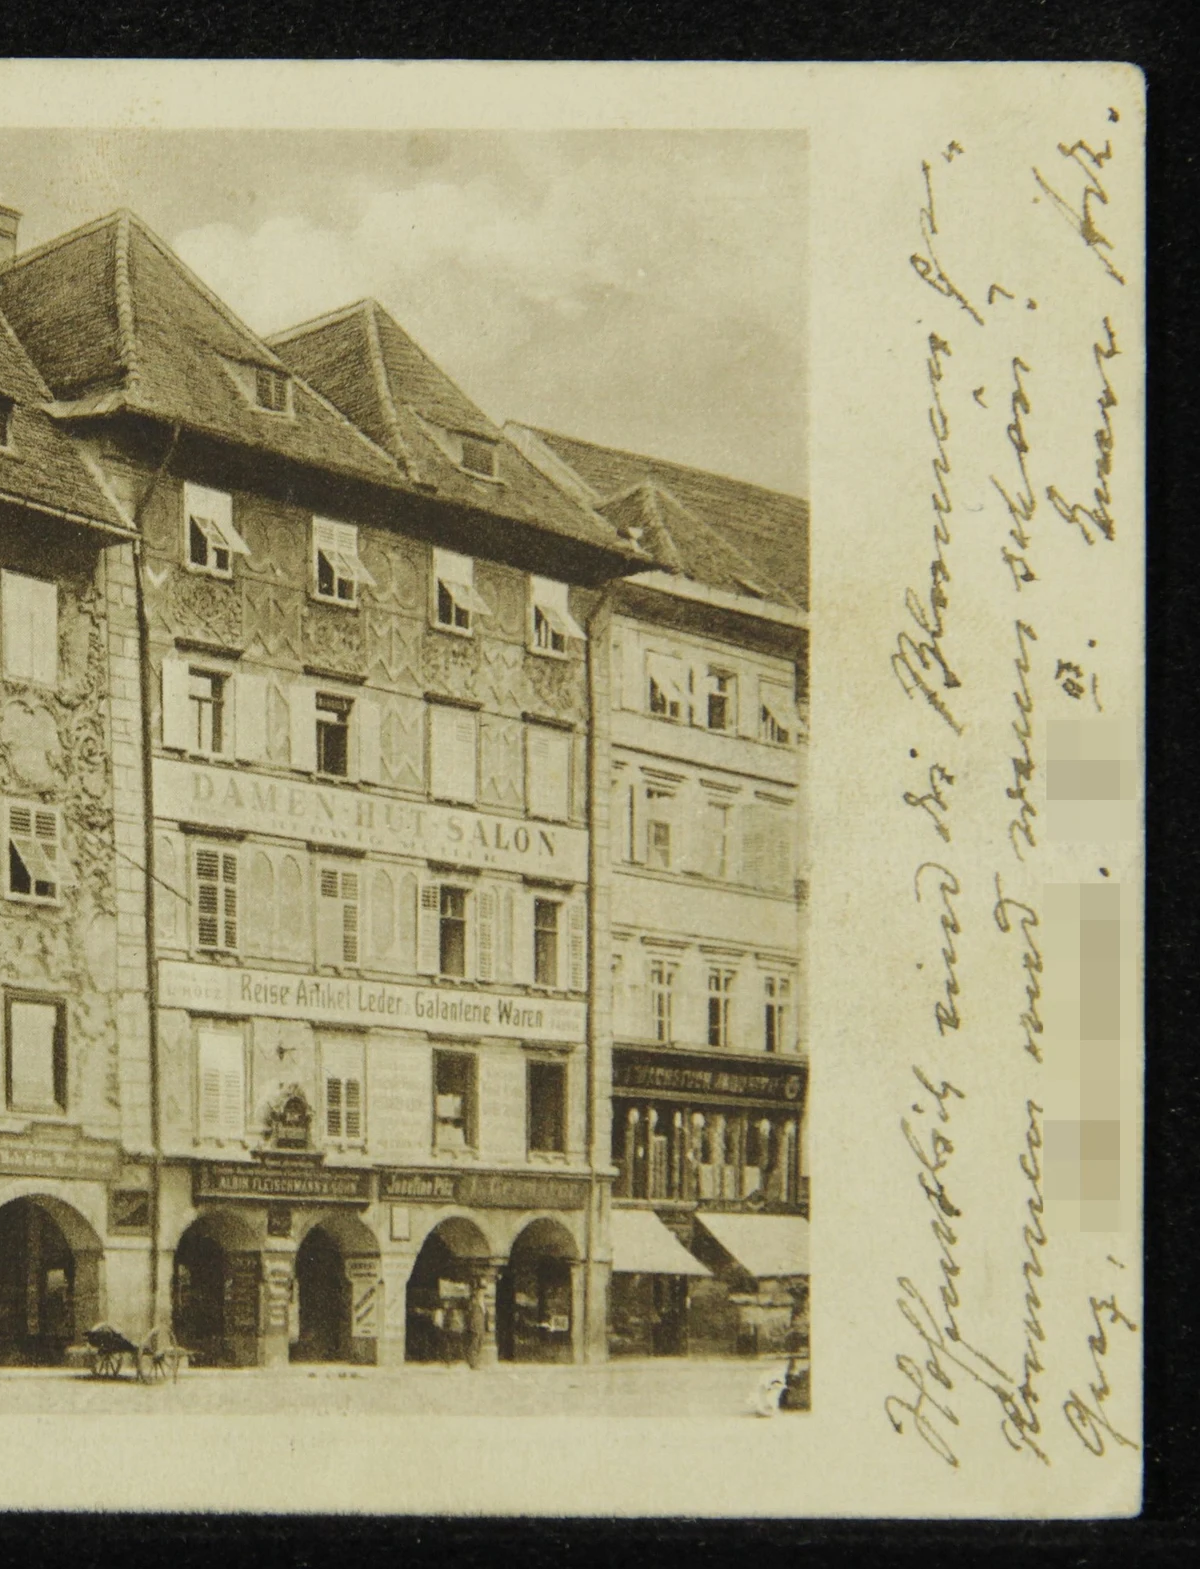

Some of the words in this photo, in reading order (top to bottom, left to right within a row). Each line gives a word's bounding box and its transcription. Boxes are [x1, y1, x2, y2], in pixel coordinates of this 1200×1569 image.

[191, 771, 336, 821] DAMEN
[356, 799, 427, 838] HUT
[446, 814, 556, 857] SALON
[240, 973, 291, 1006] Reise
[357, 985, 401, 1016] Leder
[497, 999, 544, 1029] Waren
